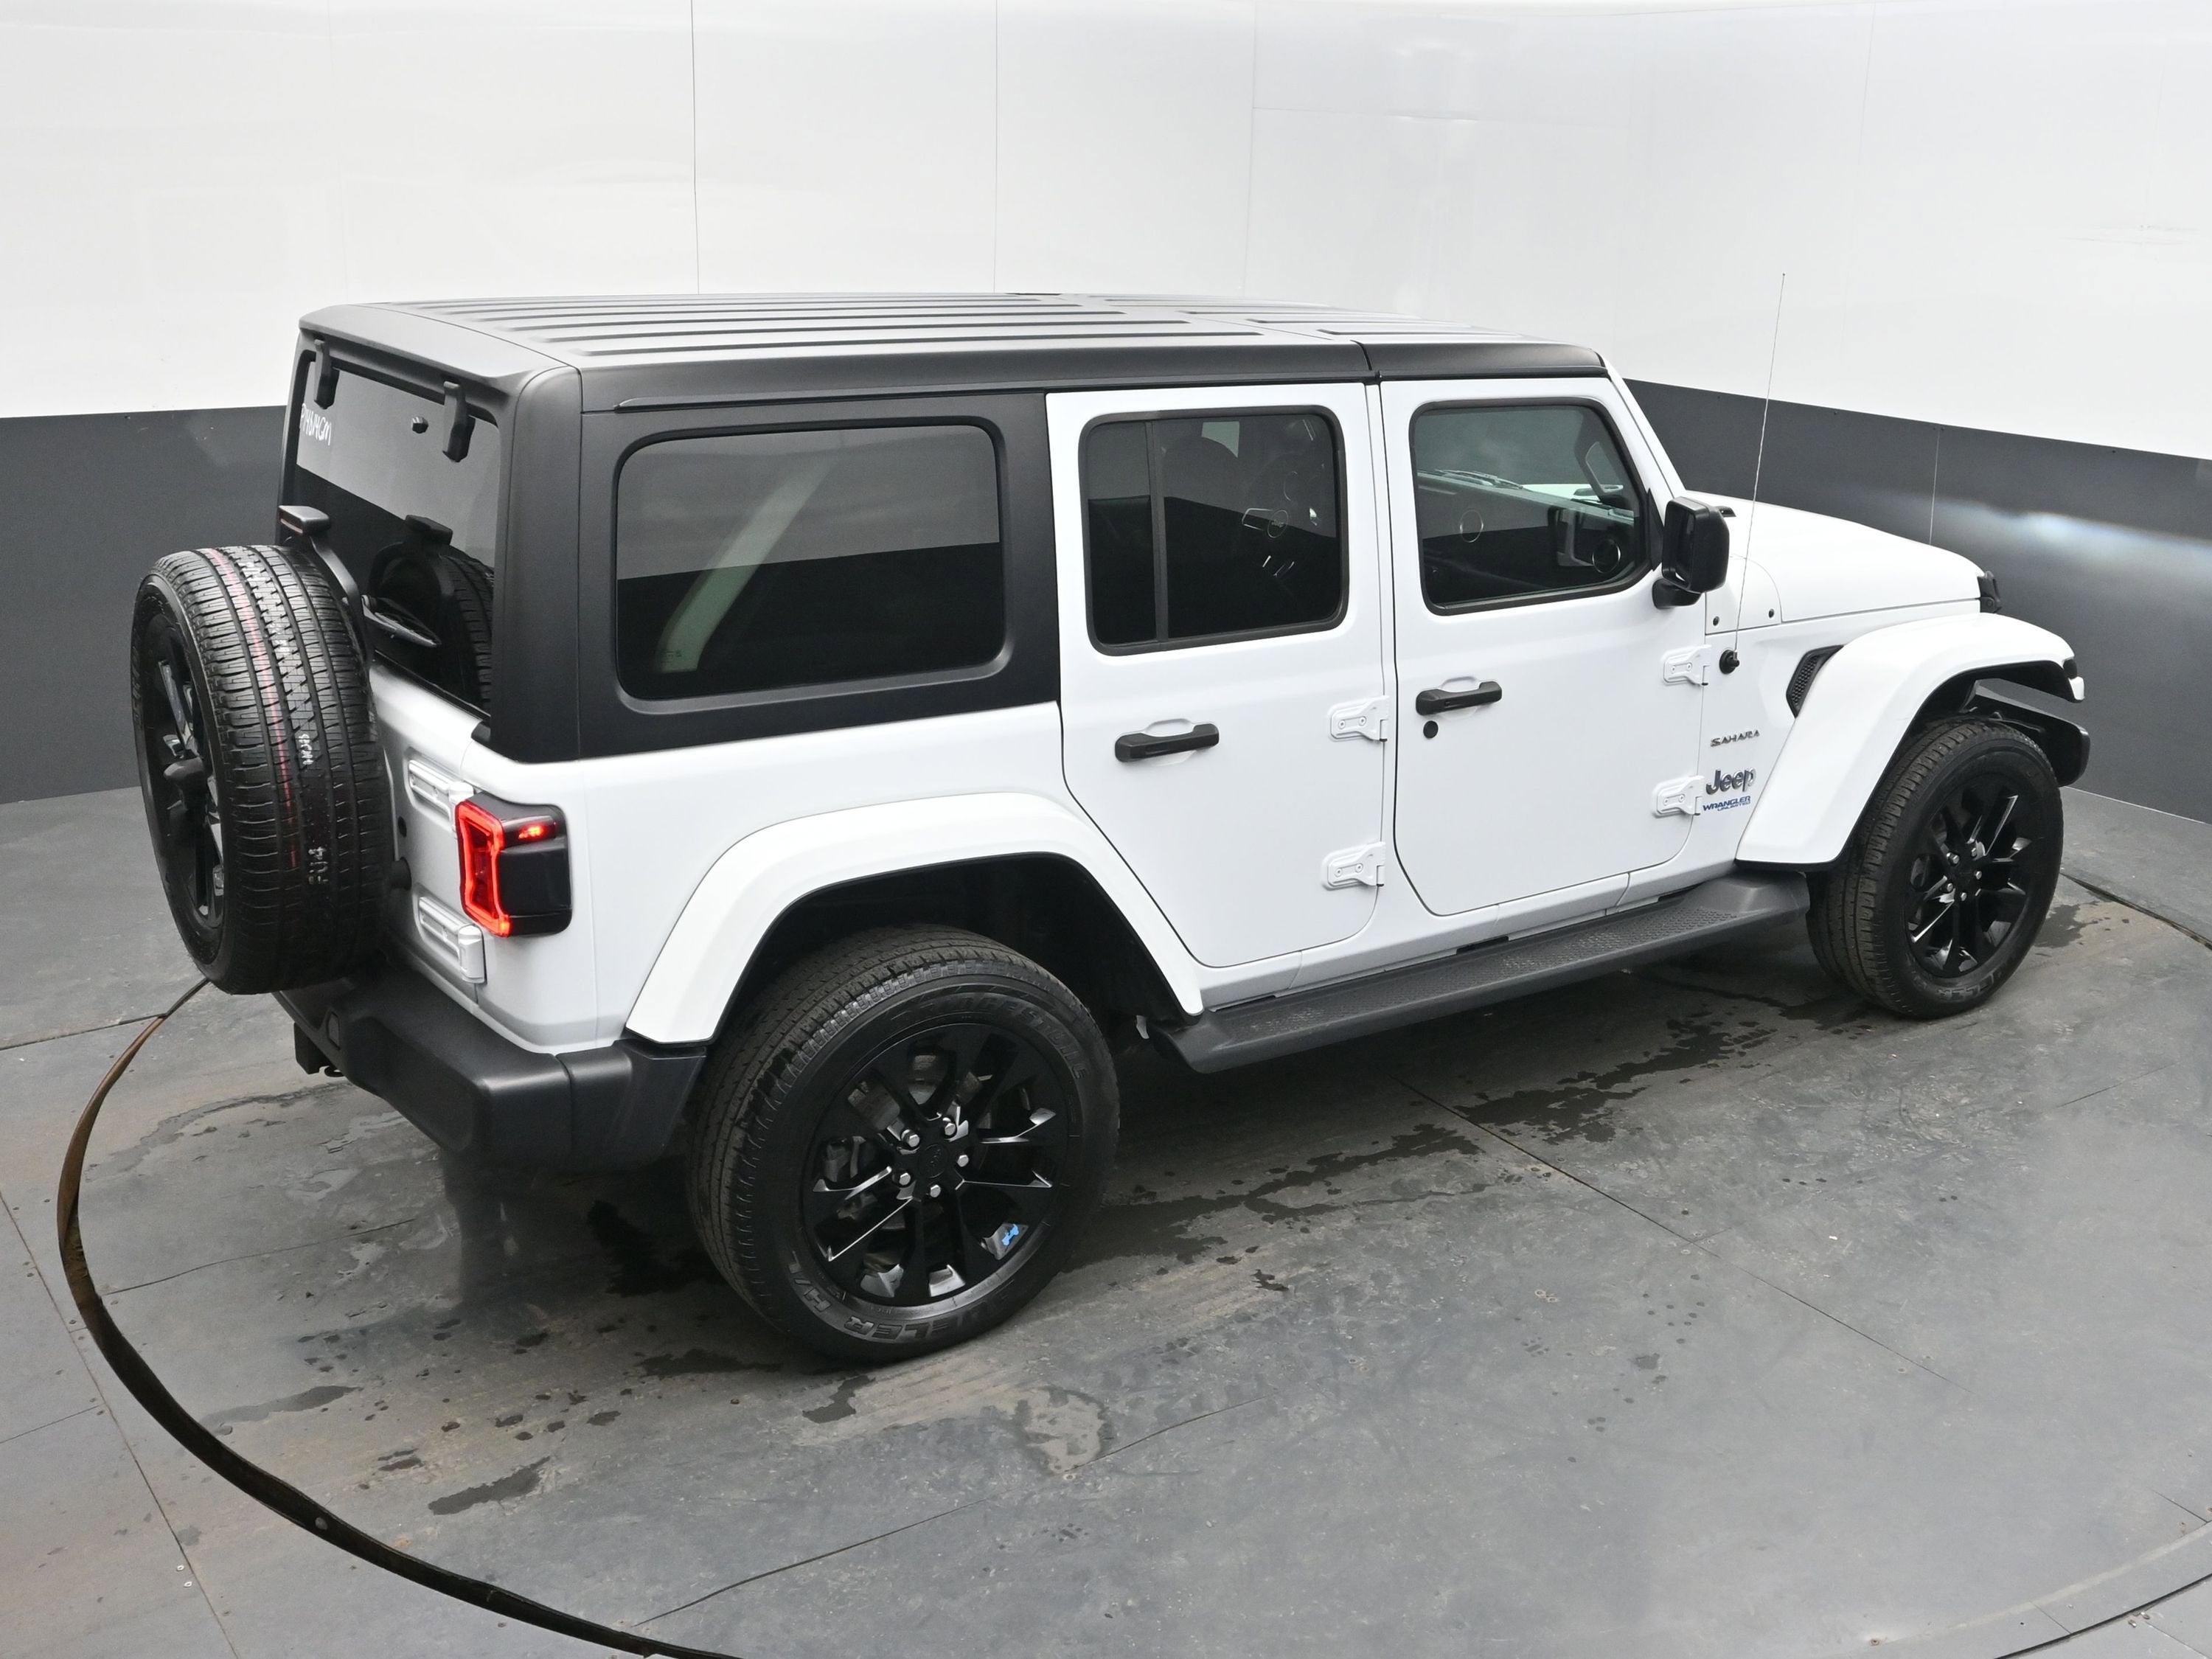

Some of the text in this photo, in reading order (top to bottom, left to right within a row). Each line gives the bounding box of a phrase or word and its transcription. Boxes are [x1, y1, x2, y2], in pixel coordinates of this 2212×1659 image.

[1711, 730, 1760, 747] SAHARA
[1706, 768, 1756, 795] Jeep
[1703, 796, 1750, 811] WRANGLER
